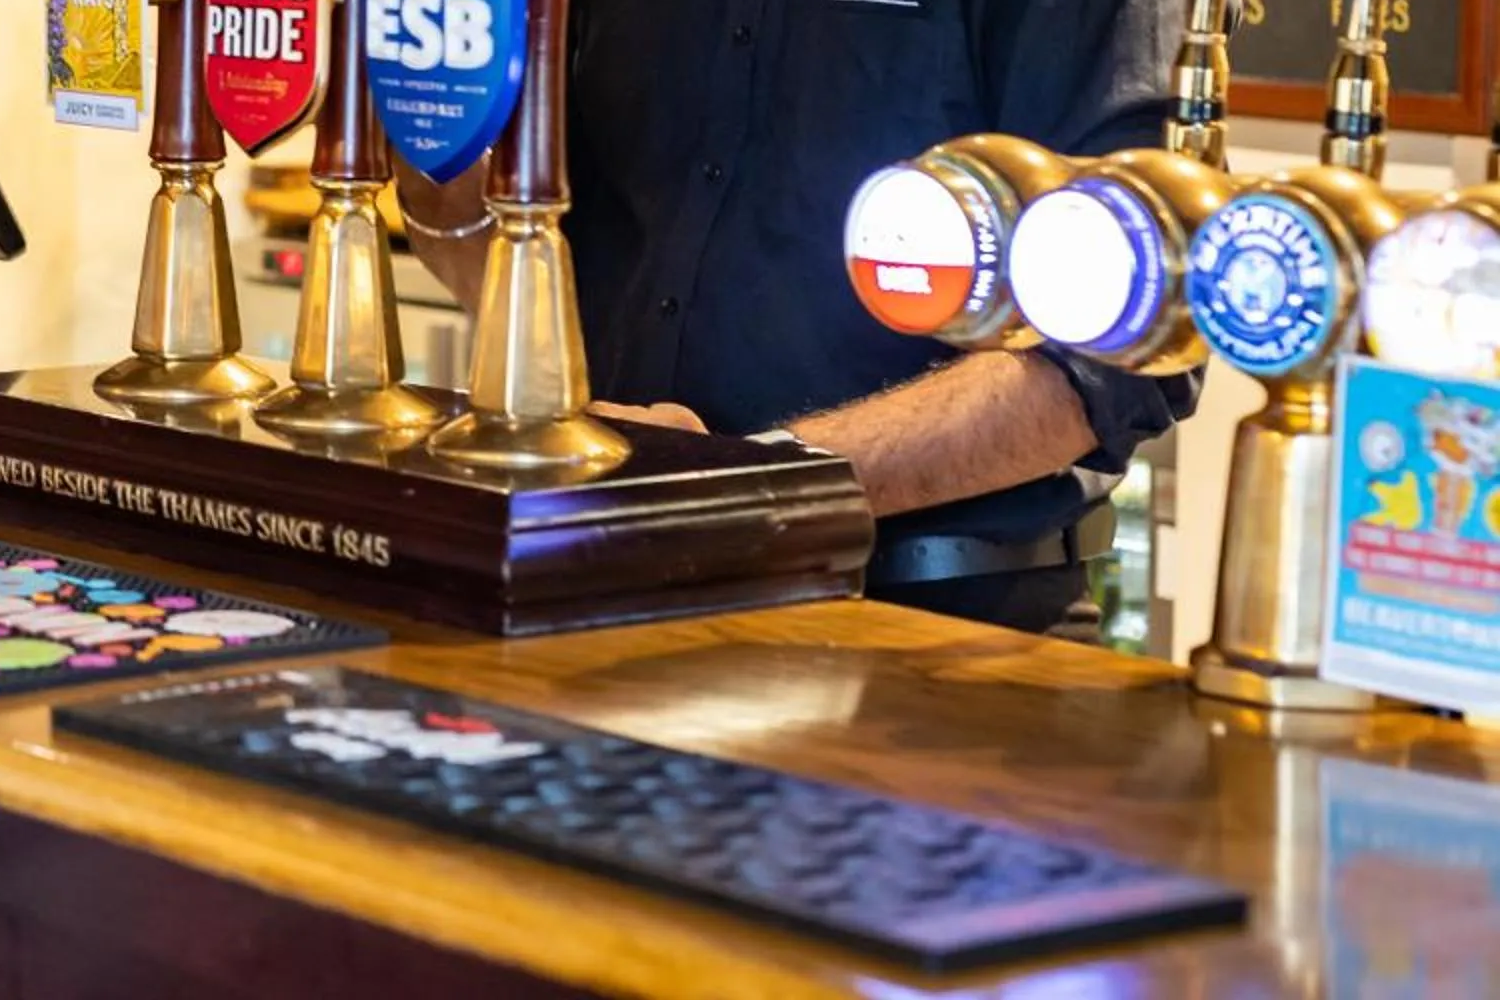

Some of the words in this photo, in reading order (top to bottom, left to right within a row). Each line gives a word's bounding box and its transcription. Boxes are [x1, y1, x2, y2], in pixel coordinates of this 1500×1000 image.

[208, 5, 305, 62] PRIDE
[41, 464, 111, 505] BESIDE
[113, 480, 157, 516] THE
[157, 489, 253, 538] THAMES
[257, 511, 325, 552] SINCE
[332, 523, 390, 568] 1845
